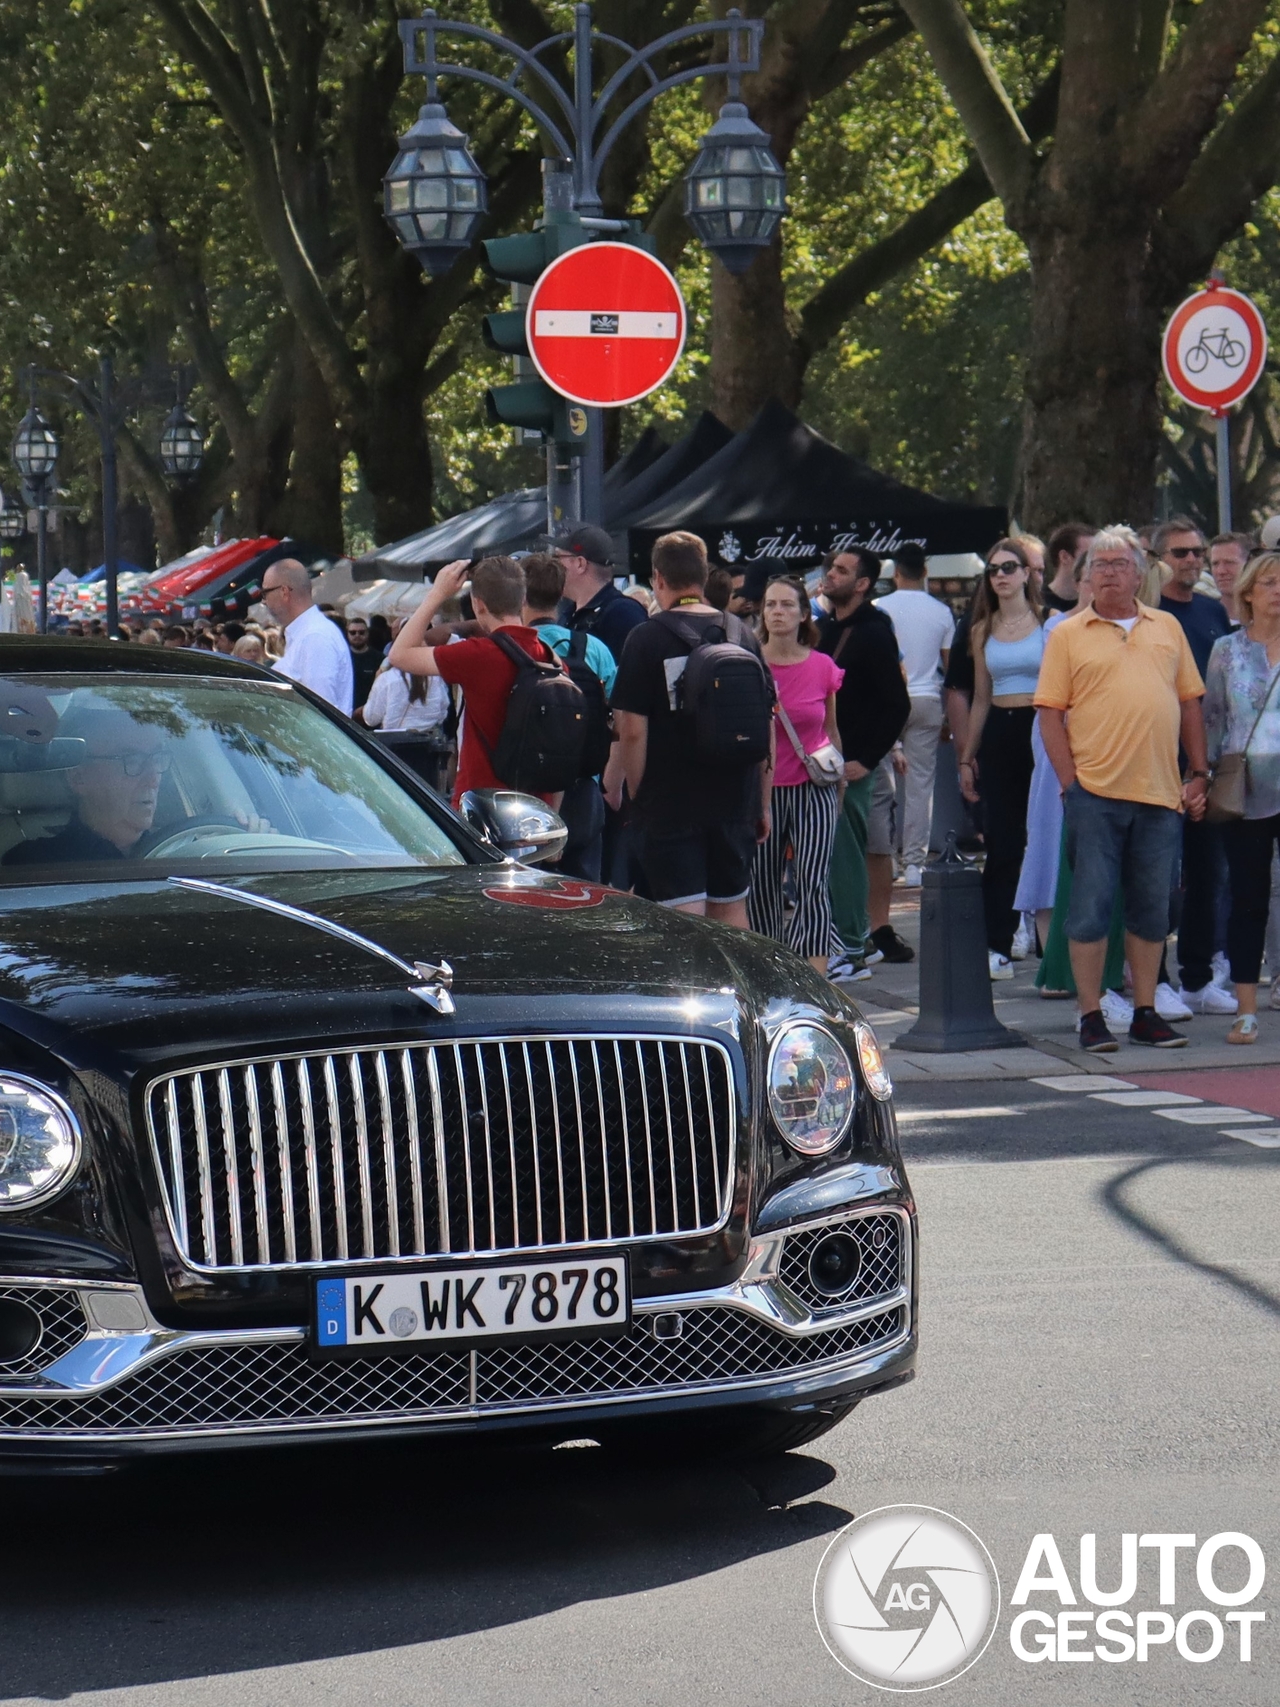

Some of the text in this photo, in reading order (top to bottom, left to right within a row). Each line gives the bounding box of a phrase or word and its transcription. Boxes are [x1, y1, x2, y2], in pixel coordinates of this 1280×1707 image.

[776, 520, 893, 533] WEINGUT
[744, 532, 816, 560] Achim
[354, 1267, 620, 1336] K WK 7878
[327, 1319, 339, 1335] D
